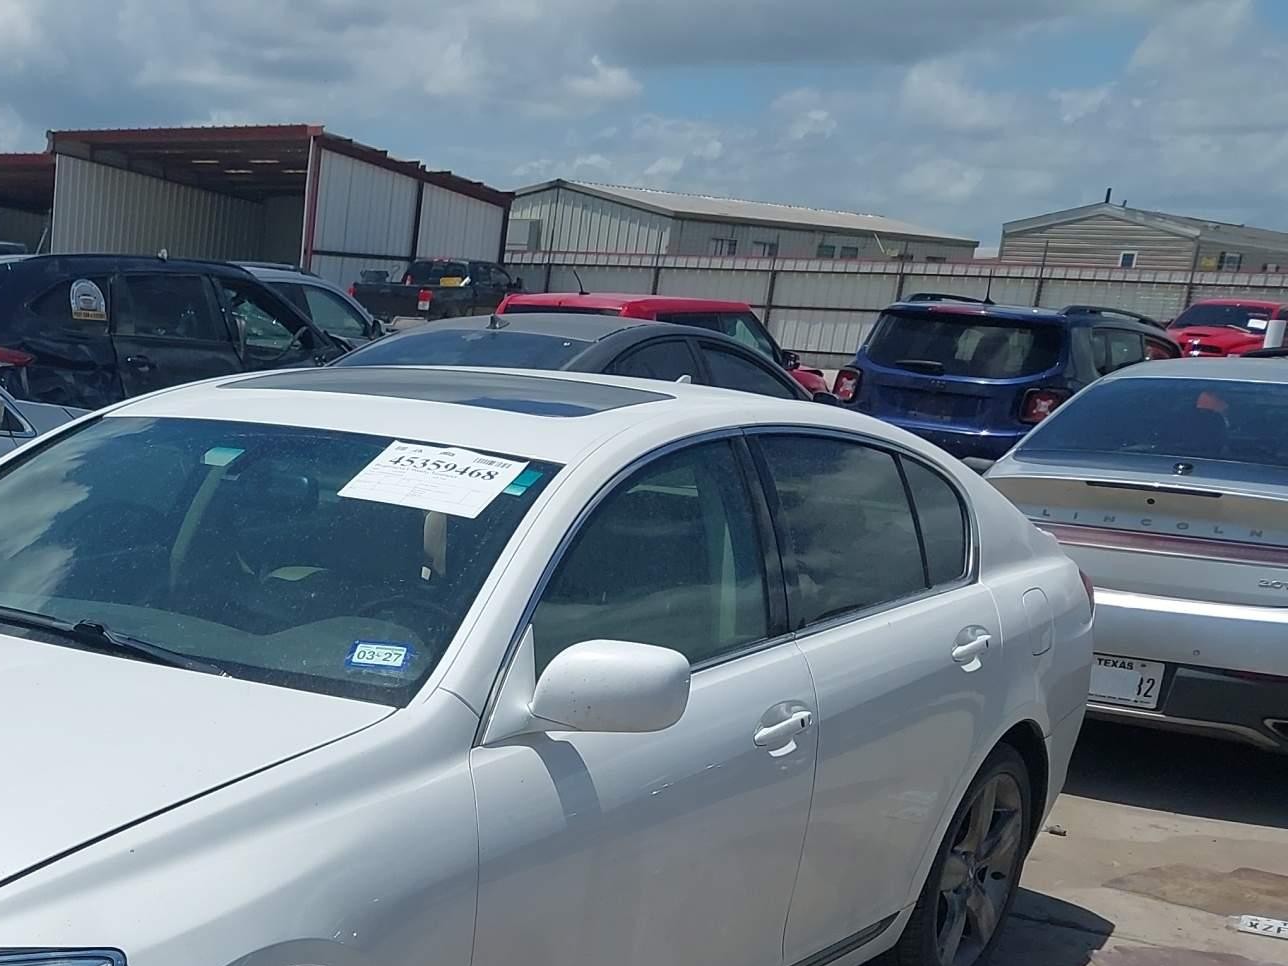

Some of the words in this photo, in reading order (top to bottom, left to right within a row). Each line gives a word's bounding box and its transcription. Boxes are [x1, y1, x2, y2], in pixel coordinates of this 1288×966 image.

[389, 454, 500, 481] 45359468
[1042, 508, 1263, 538] LINCOLN
[1097, 657, 1134, 670] TEXAS
